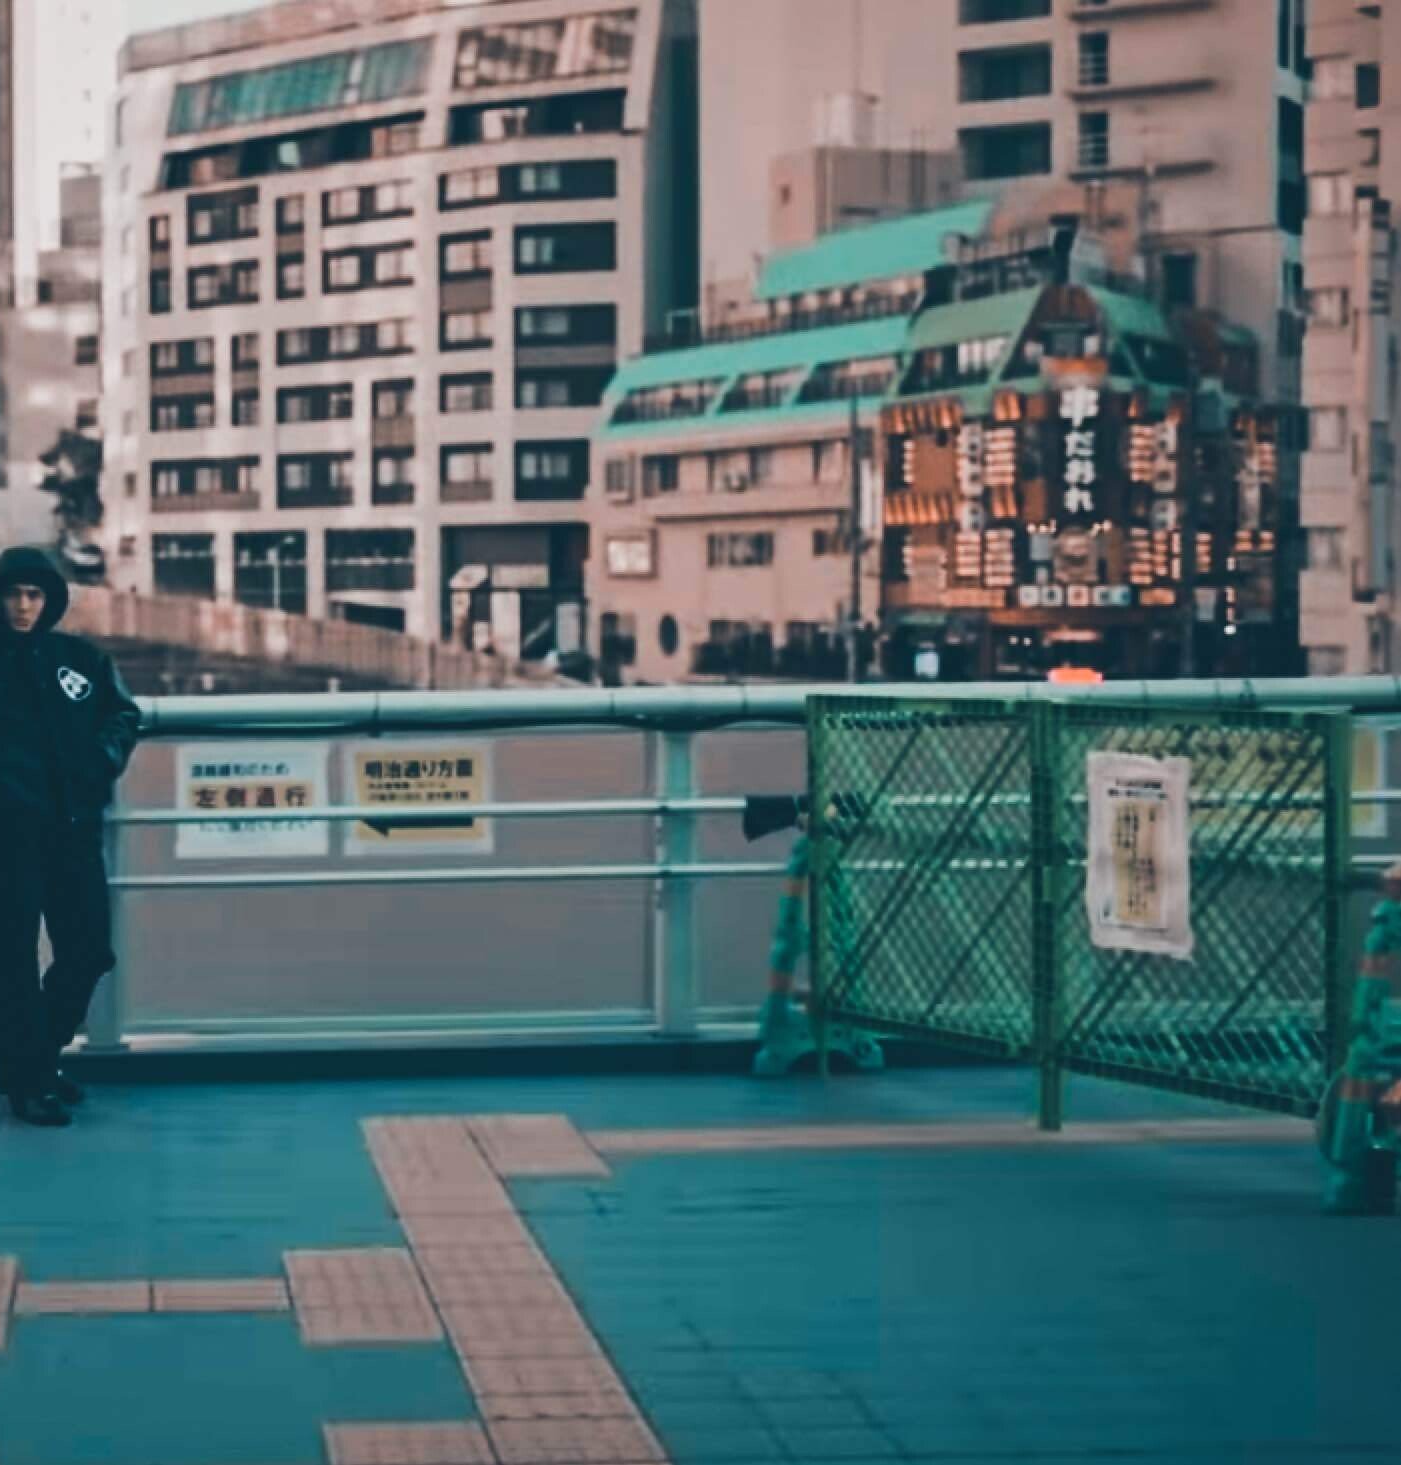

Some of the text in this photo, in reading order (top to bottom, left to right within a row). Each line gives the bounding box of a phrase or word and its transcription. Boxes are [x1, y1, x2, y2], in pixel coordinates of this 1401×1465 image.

[365, 759, 473, 778] 明治通り方面
[194, 785, 307, 808] 左側通行
